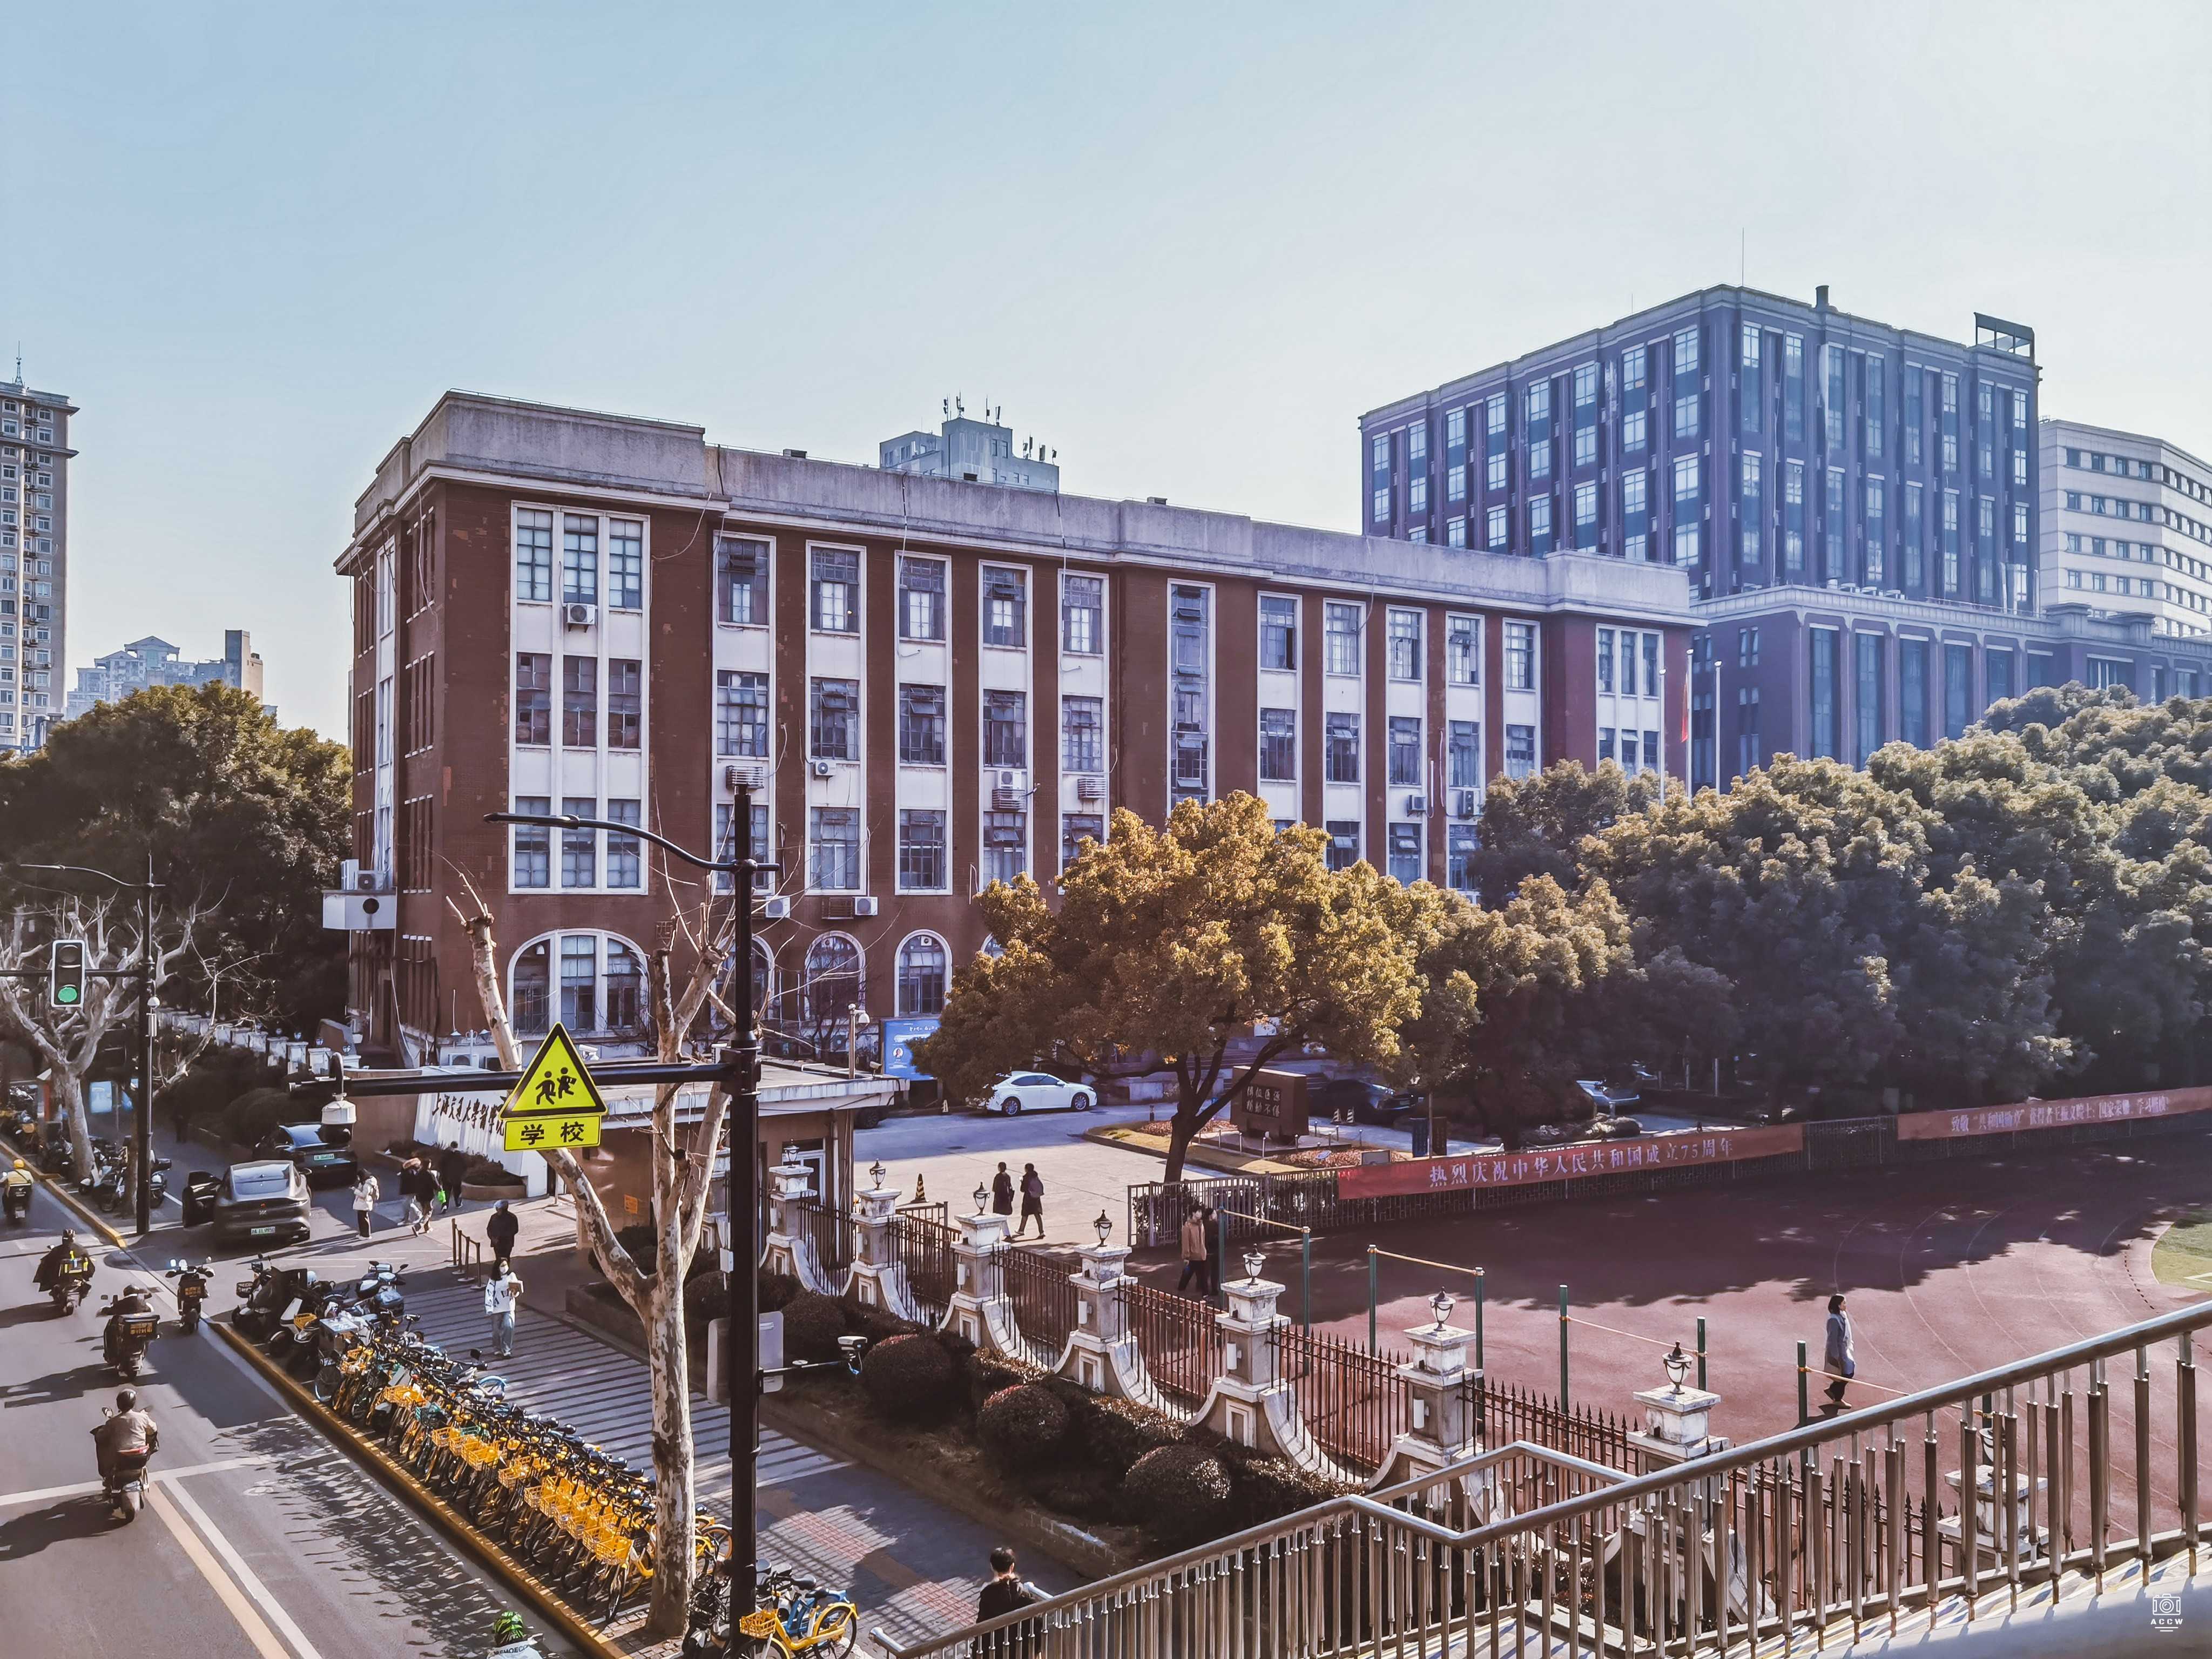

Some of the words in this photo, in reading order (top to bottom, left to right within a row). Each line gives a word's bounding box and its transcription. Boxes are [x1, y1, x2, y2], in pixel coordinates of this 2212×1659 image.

[520, 1121, 584, 1145] 学校
[1429, 1137, 1733, 1187] 热烈庆祝中华人民共和国成立75周年
